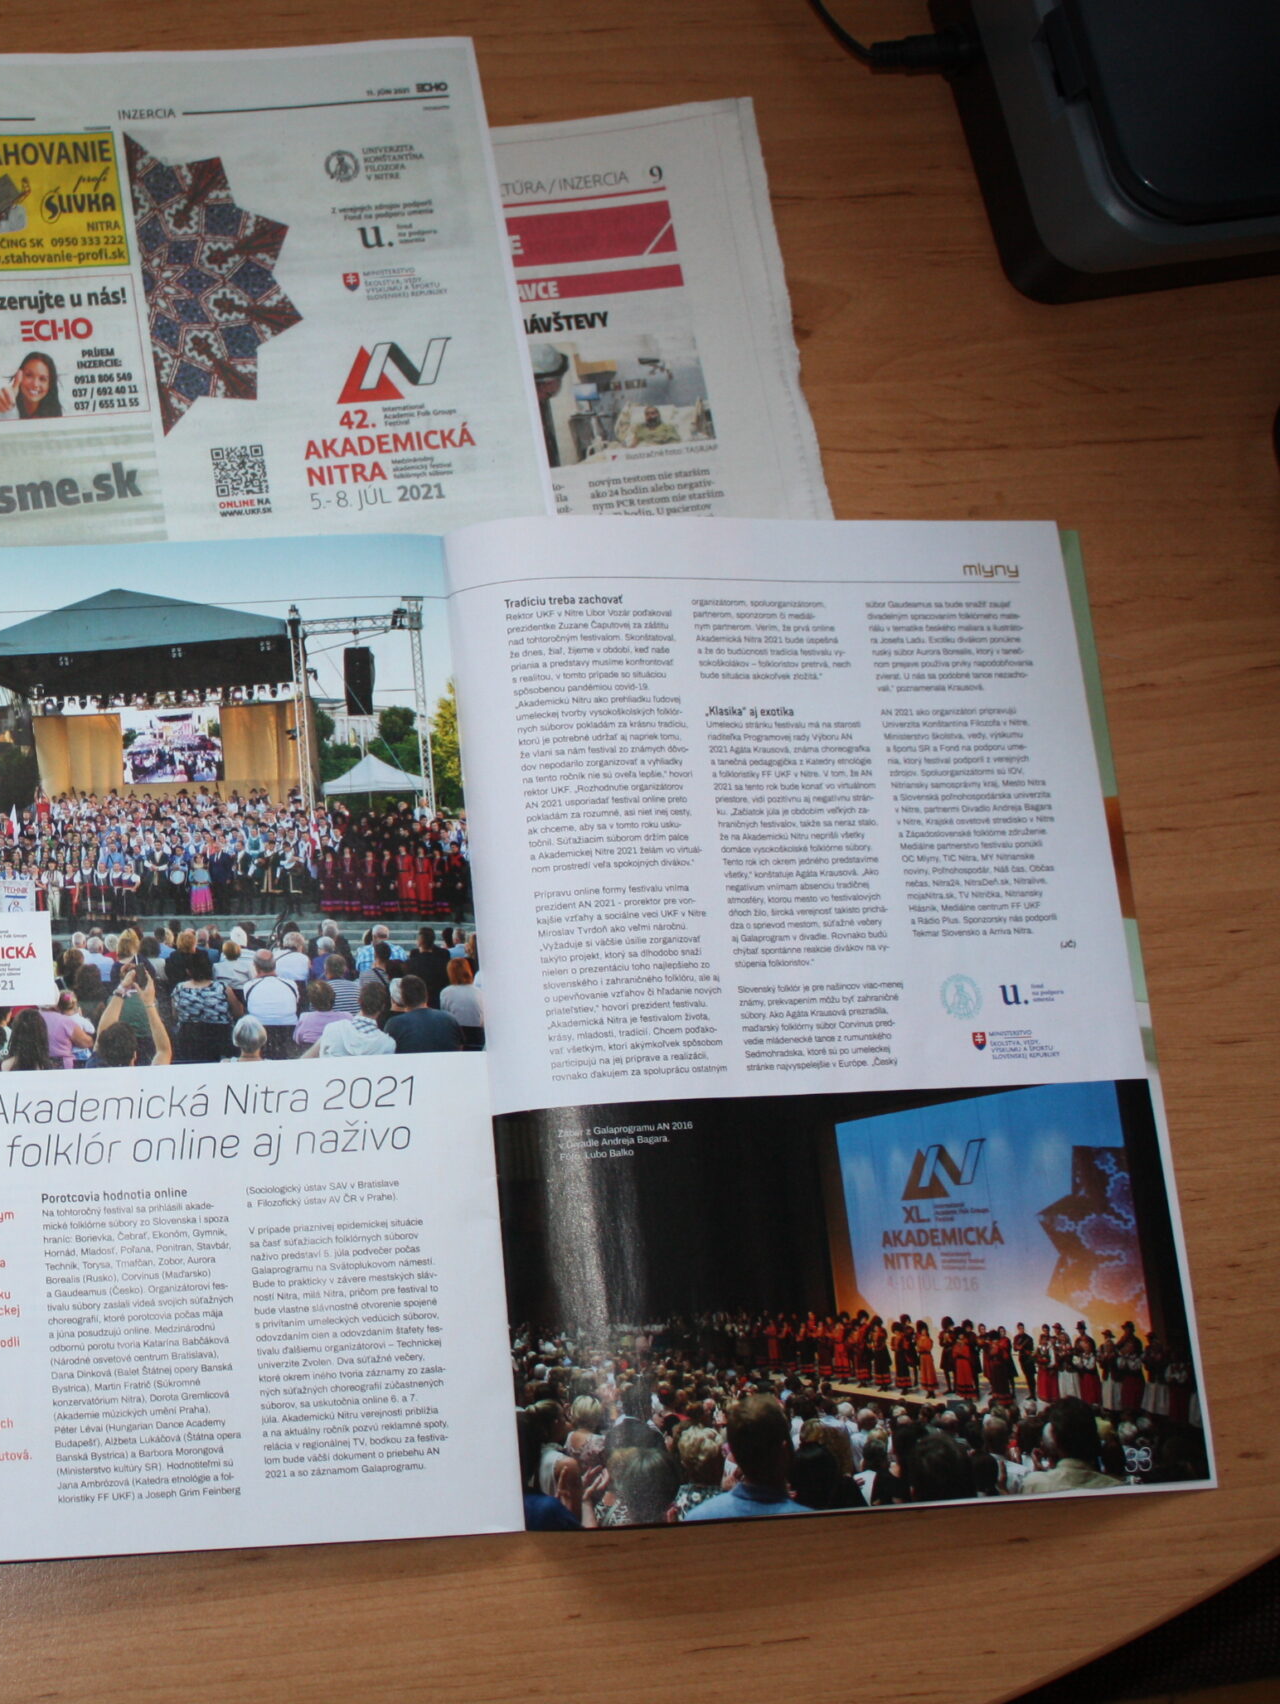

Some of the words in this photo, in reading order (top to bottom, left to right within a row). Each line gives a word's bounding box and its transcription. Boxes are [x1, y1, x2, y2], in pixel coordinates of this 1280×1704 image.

[118, 108, 176, 120] INZERCIA
[649, 165, 663, 184] 9
[501, 180, 547, 197] TÚRA
[559, 171, 629, 190] INZERCIA
[87, 221, 120, 232] NITRA
[29, 237, 44, 249] SK
[51, 236, 79, 248] 0950
[81, 235, 102, 247] 333
[103, 234, 124, 246] 222
[70, 292, 83, 307] u
[87, 286, 127, 306] nás!
[20, 317, 93, 342] ECHO
[82, 347, 115, 358] PRÍJEM
[77, 358, 122, 369] INZERCIE:
[74, 375, 96, 385] 0918
[98, 373, 114, 383] 806
[116, 372, 132, 382] 549
[339, 409, 377, 431] 42.
[304, 422, 476, 460] AKADEMICKÁ
[307, 461, 388, 488] NITRA
[219, 498, 256, 509] ONLINE
[258, 498, 270, 508] NA
[358, 486, 392, 511] JÚL
[397, 482, 446, 502] 2021
[219, 506, 272, 518] WWW.UKF.SK
[504, 597, 546, 608] Tradíciu
[548, 596, 576, 605] treba
[578, 594, 623, 605] zachovať
[224, 1083, 309, 1116] Nitra
[322, 1074, 416, 1113] 2021
[6, 1132, 121, 1168] folklór
[132, 1128, 241, 1164] online
[253, 1132, 283, 1166] aj
[294, 1123, 413, 1158] naživo
[41, 1193, 100, 1204] Porotcovia
[103, 1190, 151, 1201] hodnotia
[154, 1188, 187, 1199] online
[902, 1206, 931, 1224] XL.
[882, 1220, 1004, 1248] AKADEMICKÁ
[883, 1253, 937, 1271] NITRA
